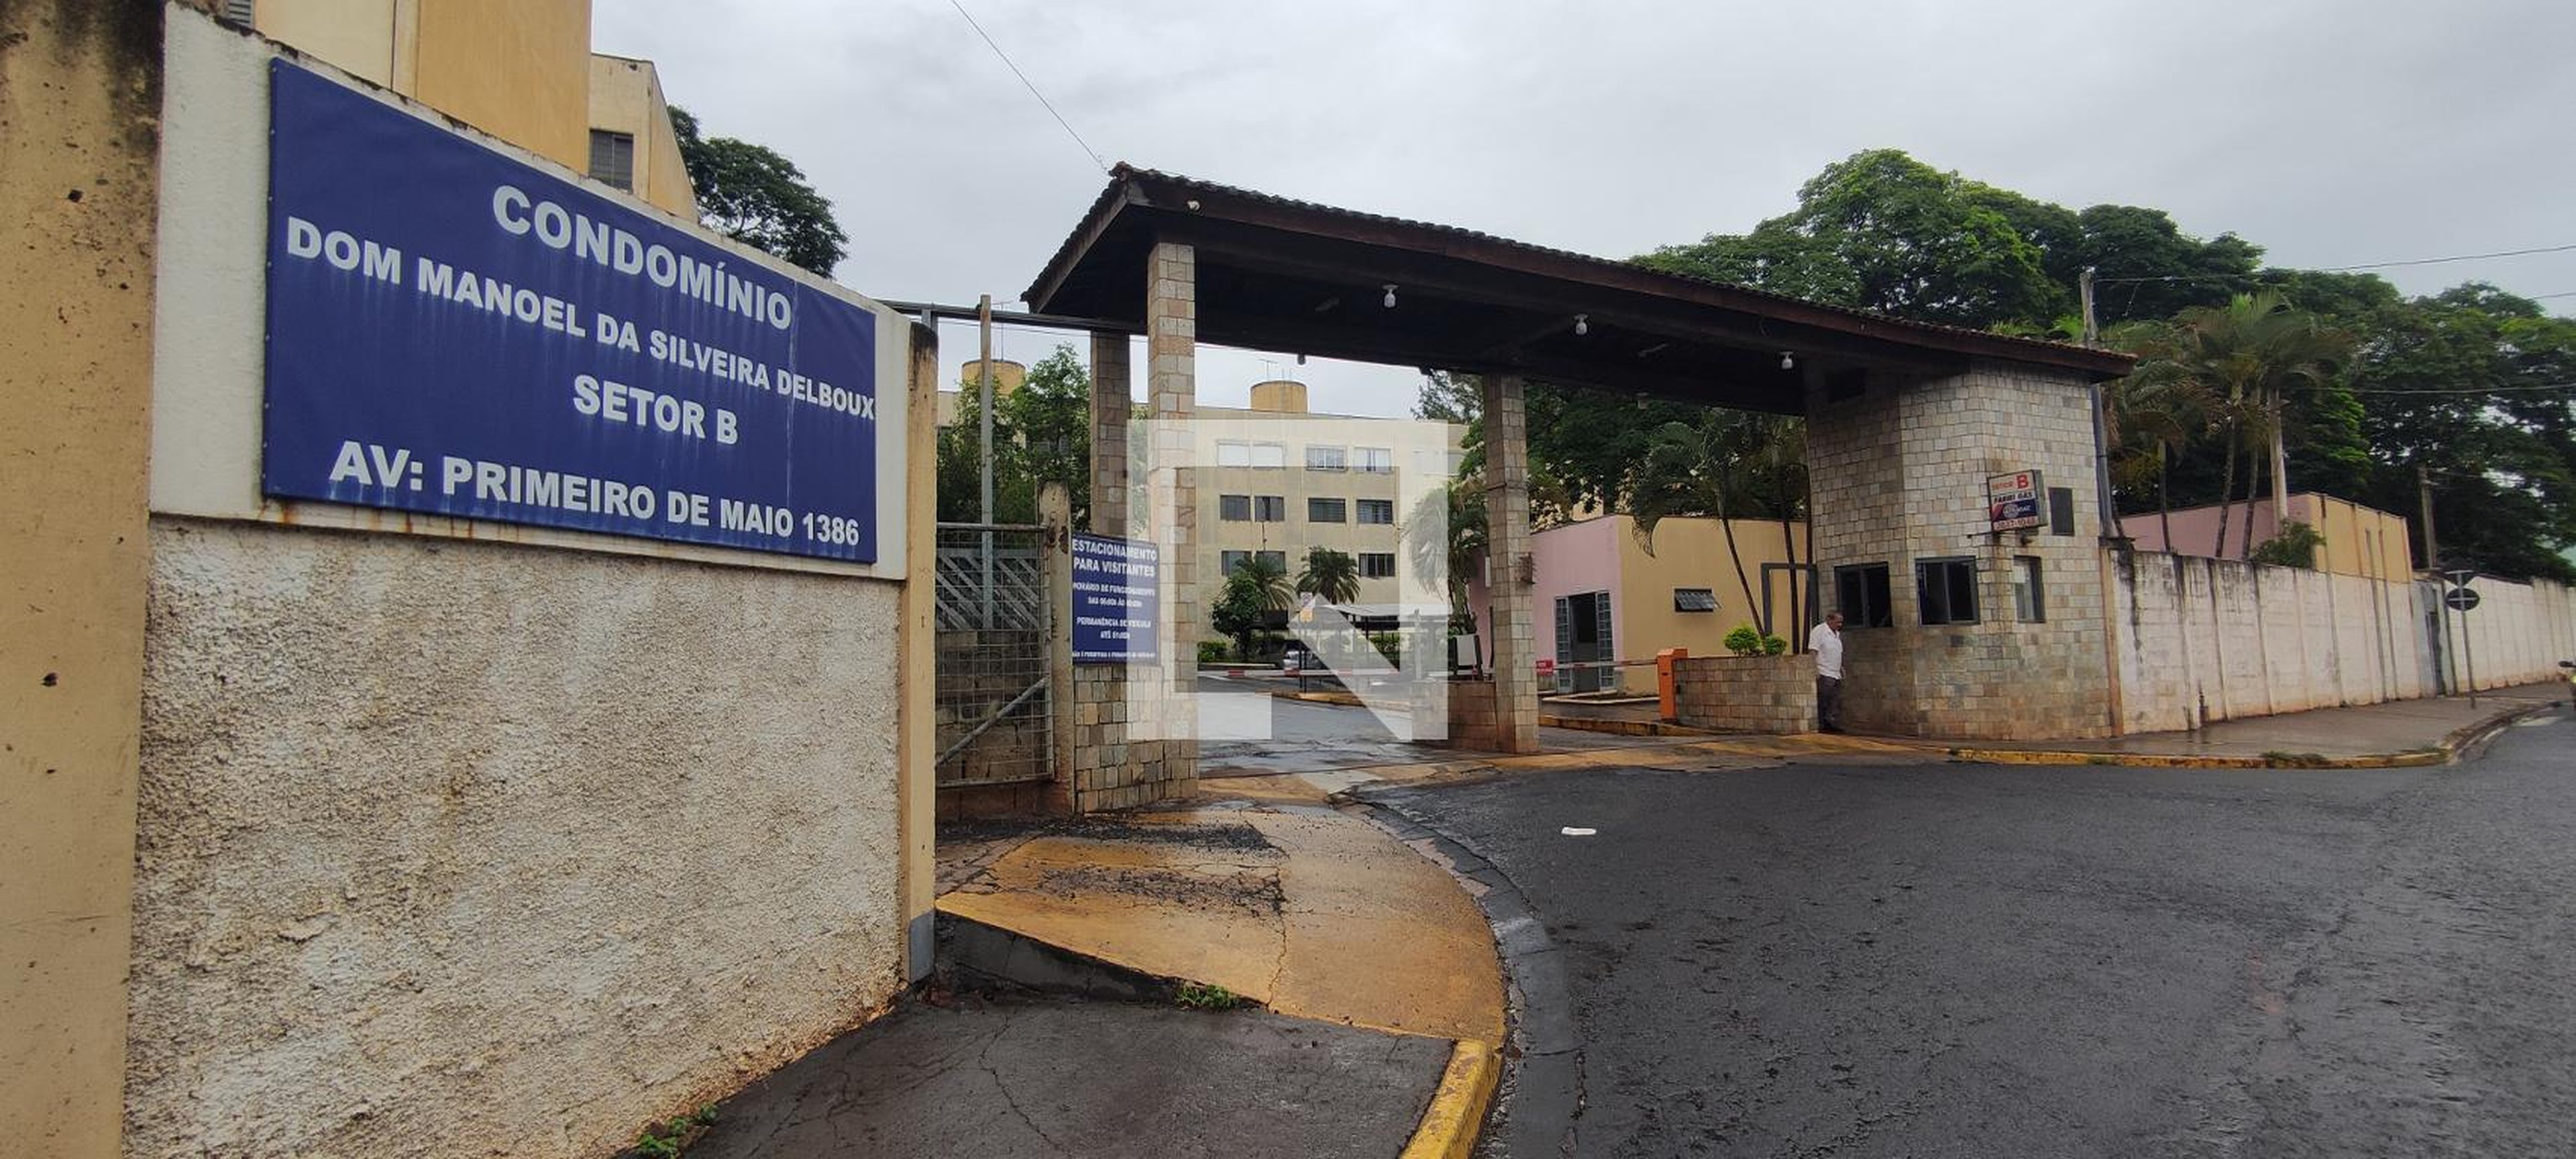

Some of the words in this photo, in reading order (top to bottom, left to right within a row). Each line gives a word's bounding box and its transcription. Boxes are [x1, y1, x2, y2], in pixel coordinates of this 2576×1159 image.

[492, 185, 792, 330] CONDOMÍNIO
[286, 215, 401, 285] DOM
[417, 256, 586, 338] MANOEL
[596, 312, 641, 354] DA
[649, 329, 771, 391] SILVEIRA
[777, 368, 875, 421] DELBOUX
[572, 374, 706, 440] SETOR
[716, 408, 739, 445] B
[328, 440, 423, 491] AV:
[442, 455, 656, 520] PRIMEIRO
[667, 490, 710, 527] DE
[719, 498, 794, 538] MAIO
[802, 511, 859, 546] 1386
[2017, 474, 2029, 489] B
[1073, 538, 1157, 561] ESTACIONAMENTO
[1073, 557, 1099, 572] PARA
[1102, 562, 1155, 577] VISITANTES
